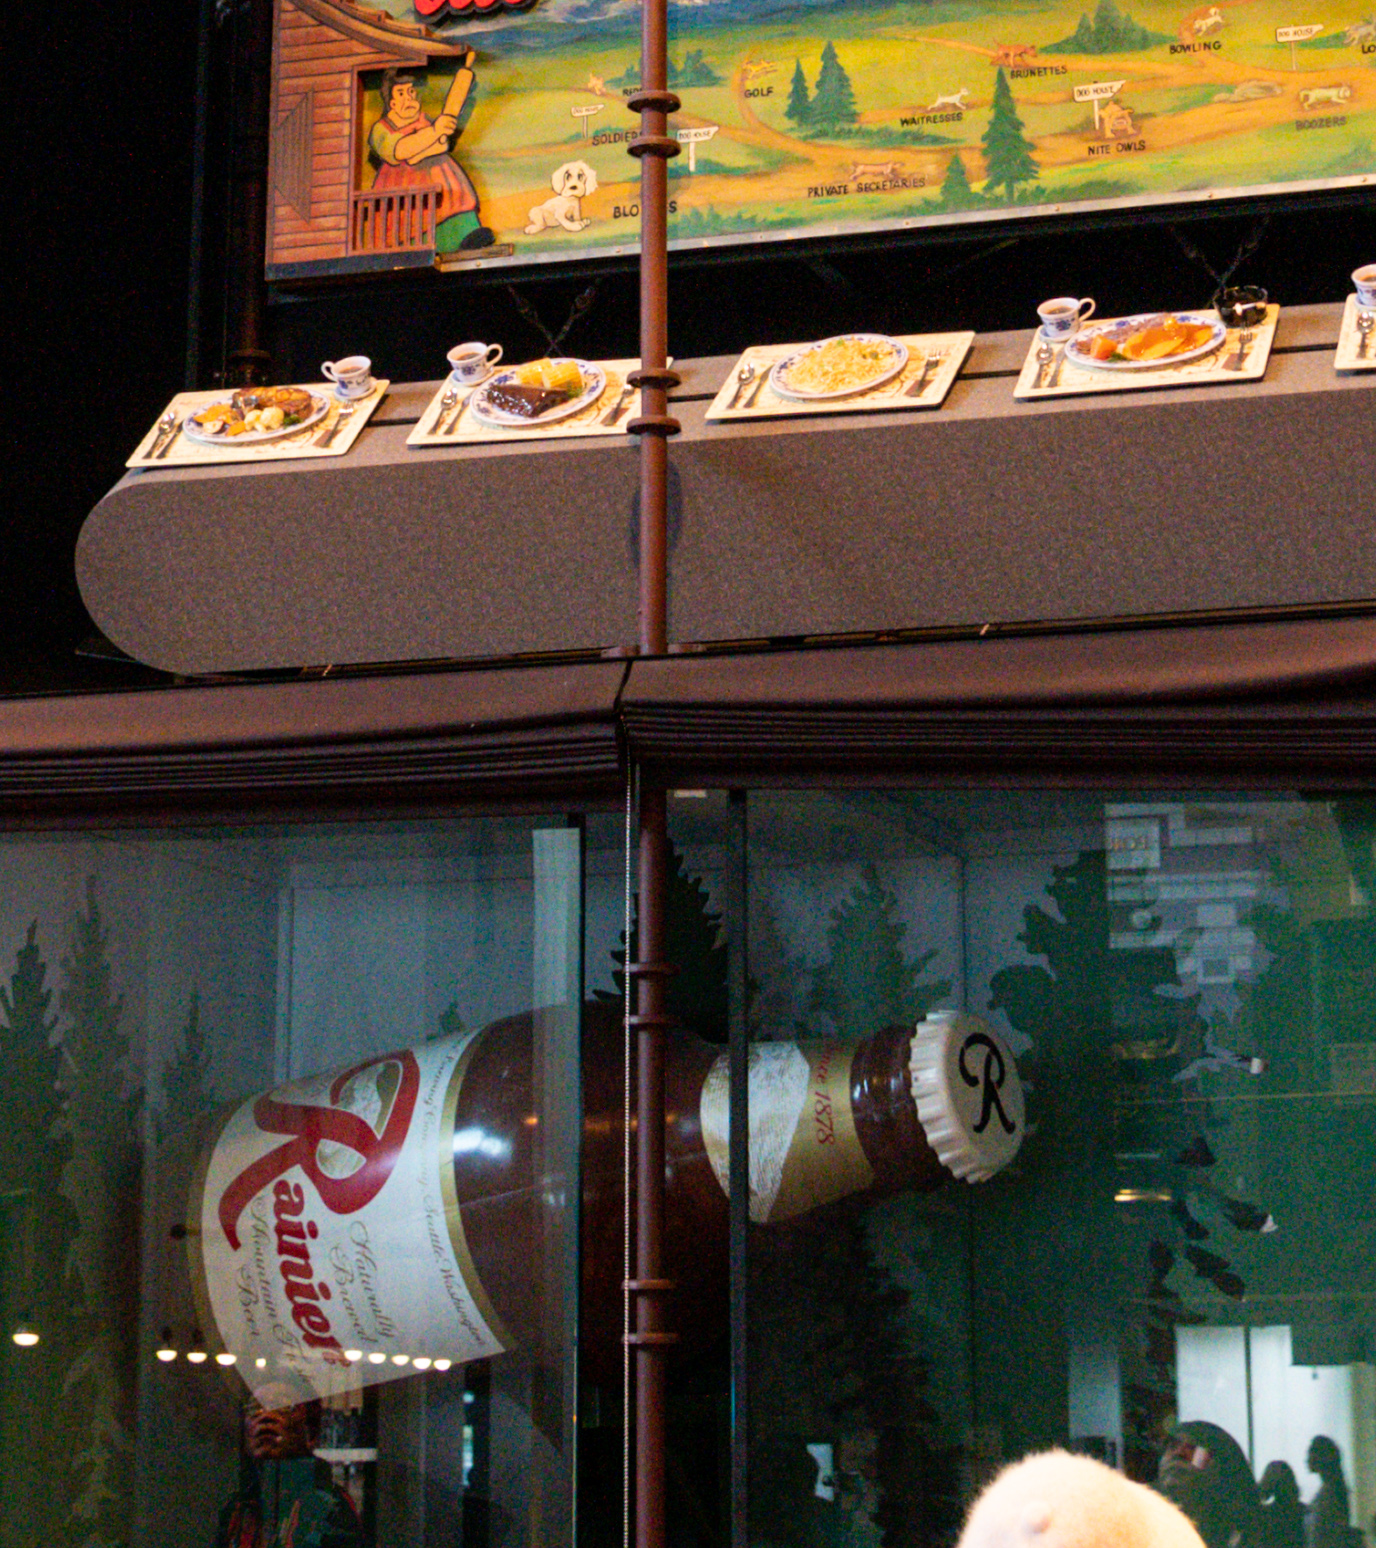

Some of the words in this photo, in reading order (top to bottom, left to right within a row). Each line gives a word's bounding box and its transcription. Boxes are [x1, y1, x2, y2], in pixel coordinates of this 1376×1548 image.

[1169, 40, 1222, 54] BOWLING
[1010, 65, 1067, 79] BRUNETTES
[744, 86, 773, 98] GOLF
[900, 112, 964, 127] WAITRESSES
[1295, 115, 1347, 131] BOOZERS
[1088, 145, 1111, 156] NITE
[1116, 140, 1146, 153] OWLS
[808, 184, 849, 198] PRIVATE
[856, 177, 926, 193] SECRETARIES
[959, 1032, 1016, 1134] R
[814, 1090, 837, 1146] 1878
[218, 1049, 420, 1368] Rainier
[350, 1220, 395, 1341] Naturally
[330, 1242, 378, 1344] Brewed
